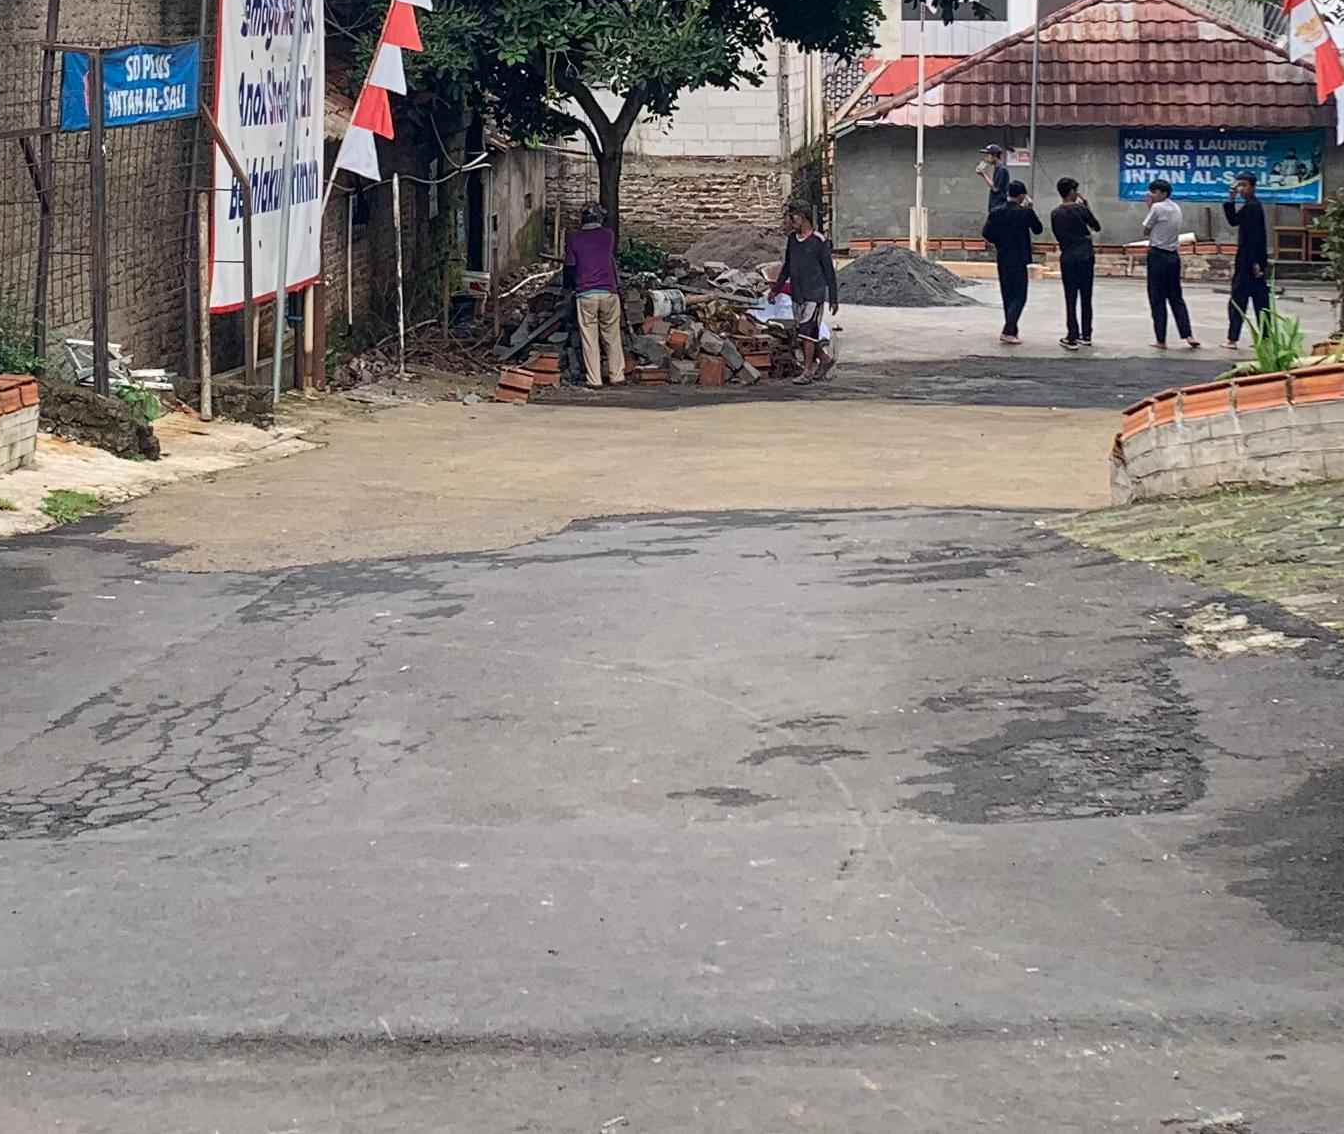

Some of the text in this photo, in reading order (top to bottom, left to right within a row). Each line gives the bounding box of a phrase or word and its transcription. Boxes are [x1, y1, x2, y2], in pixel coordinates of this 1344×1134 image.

[125, 53, 173, 82] SD PLUS
[145, 83, 187, 114] AL-SALI
[1124, 138, 1269, 151] KANTIN & LAUNDRY
[1124, 154, 1268, 170] SD, SMP, MA PLUS
[1124, 169, 1186, 184] INTAN
